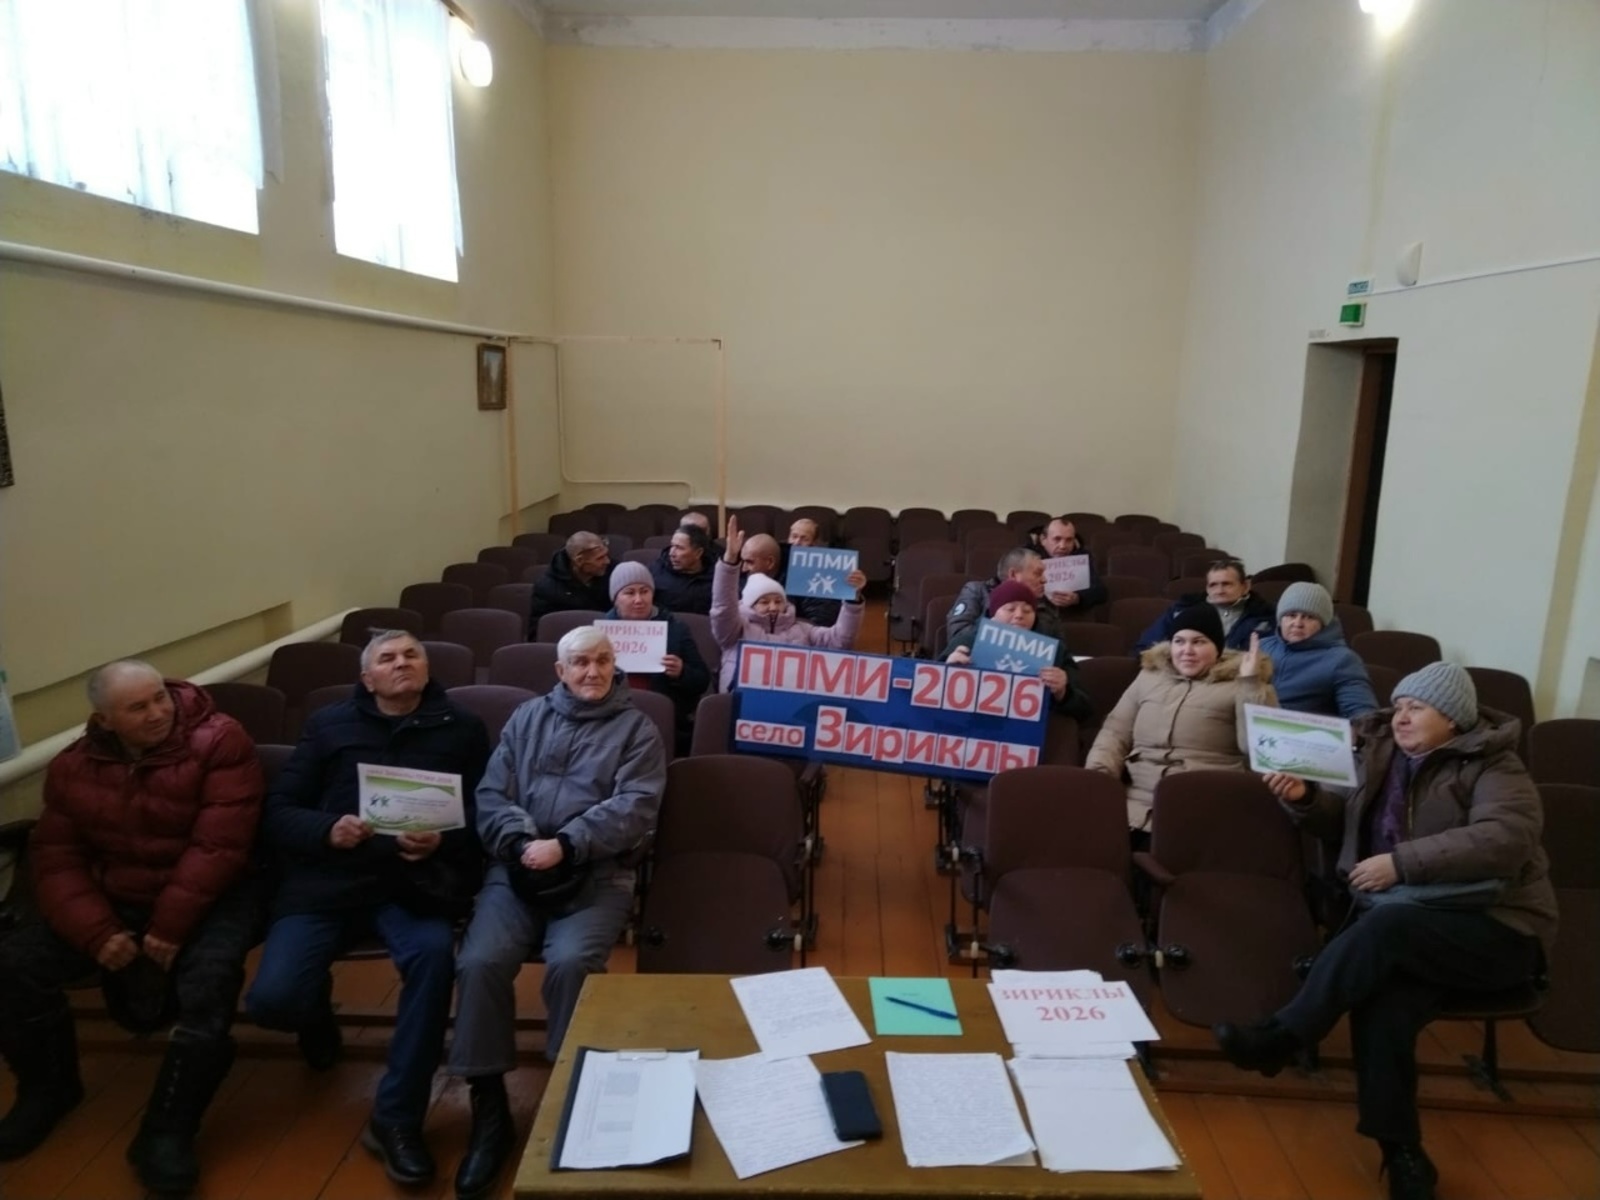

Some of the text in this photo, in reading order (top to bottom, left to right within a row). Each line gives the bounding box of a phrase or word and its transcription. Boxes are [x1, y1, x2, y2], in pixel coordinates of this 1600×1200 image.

[791, 551, 857, 571] ППМИ
[1048, 571, 1075, 583] 2026
[614, 640, 648, 654] 2026
[980, 624, 1055, 661] ППМИ
[740, 646, 1041, 718] ППМИ-2026
[737, 709, 1039, 770] село Зириклы
[1036, 1006, 1106, 1022] 2026
